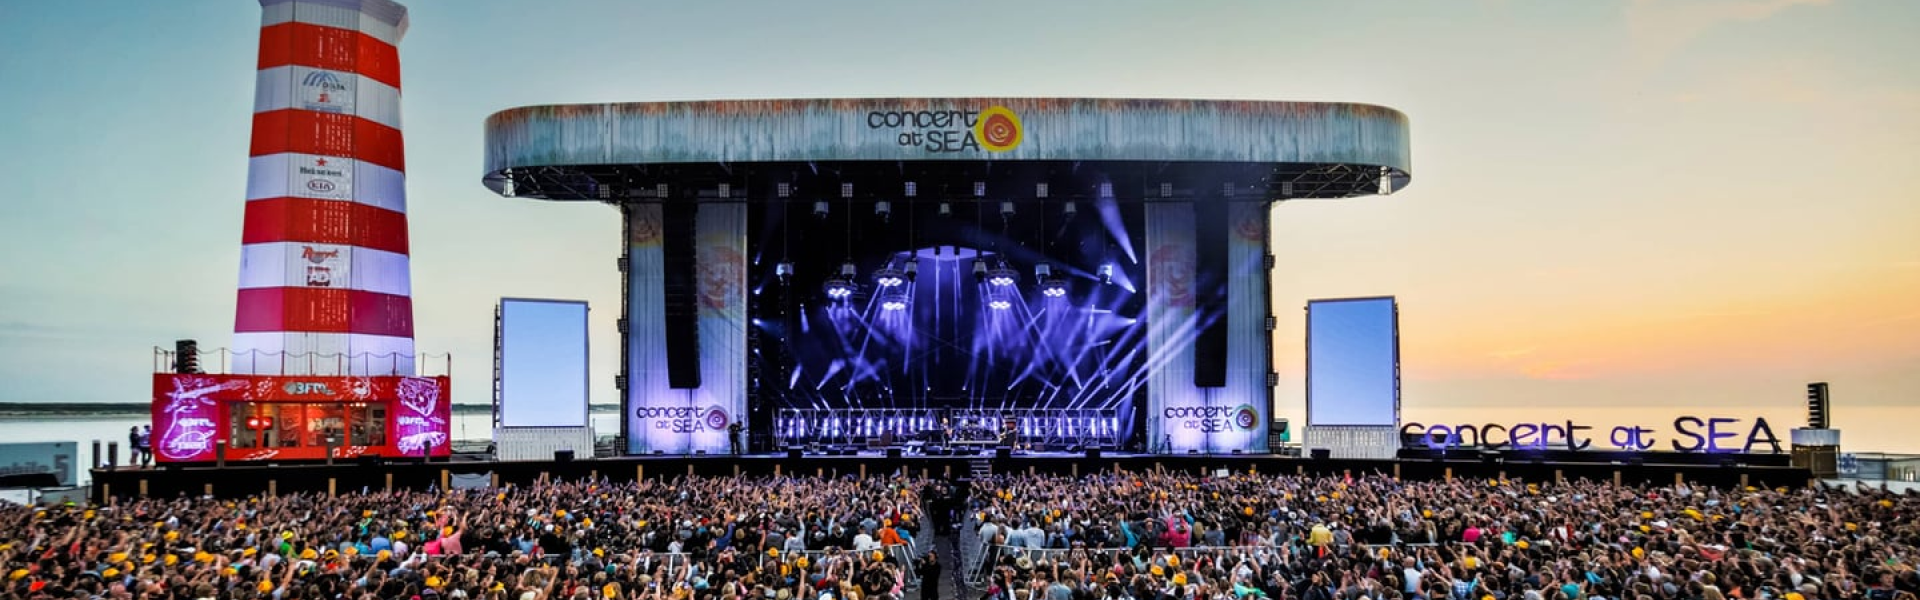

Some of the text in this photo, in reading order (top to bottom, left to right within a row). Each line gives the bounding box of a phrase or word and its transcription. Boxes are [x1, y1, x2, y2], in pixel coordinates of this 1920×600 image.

[867, 109, 979, 129] concert
[898, 130, 980, 152] at SEA
[636, 405, 705, 418] concert
[1164, 405, 1233, 418] concert
[655, 419, 705, 433] at SEA
[1183, 418, 1234, 433] at SEA
[1400, 416, 1782, 453] concert at SEA
